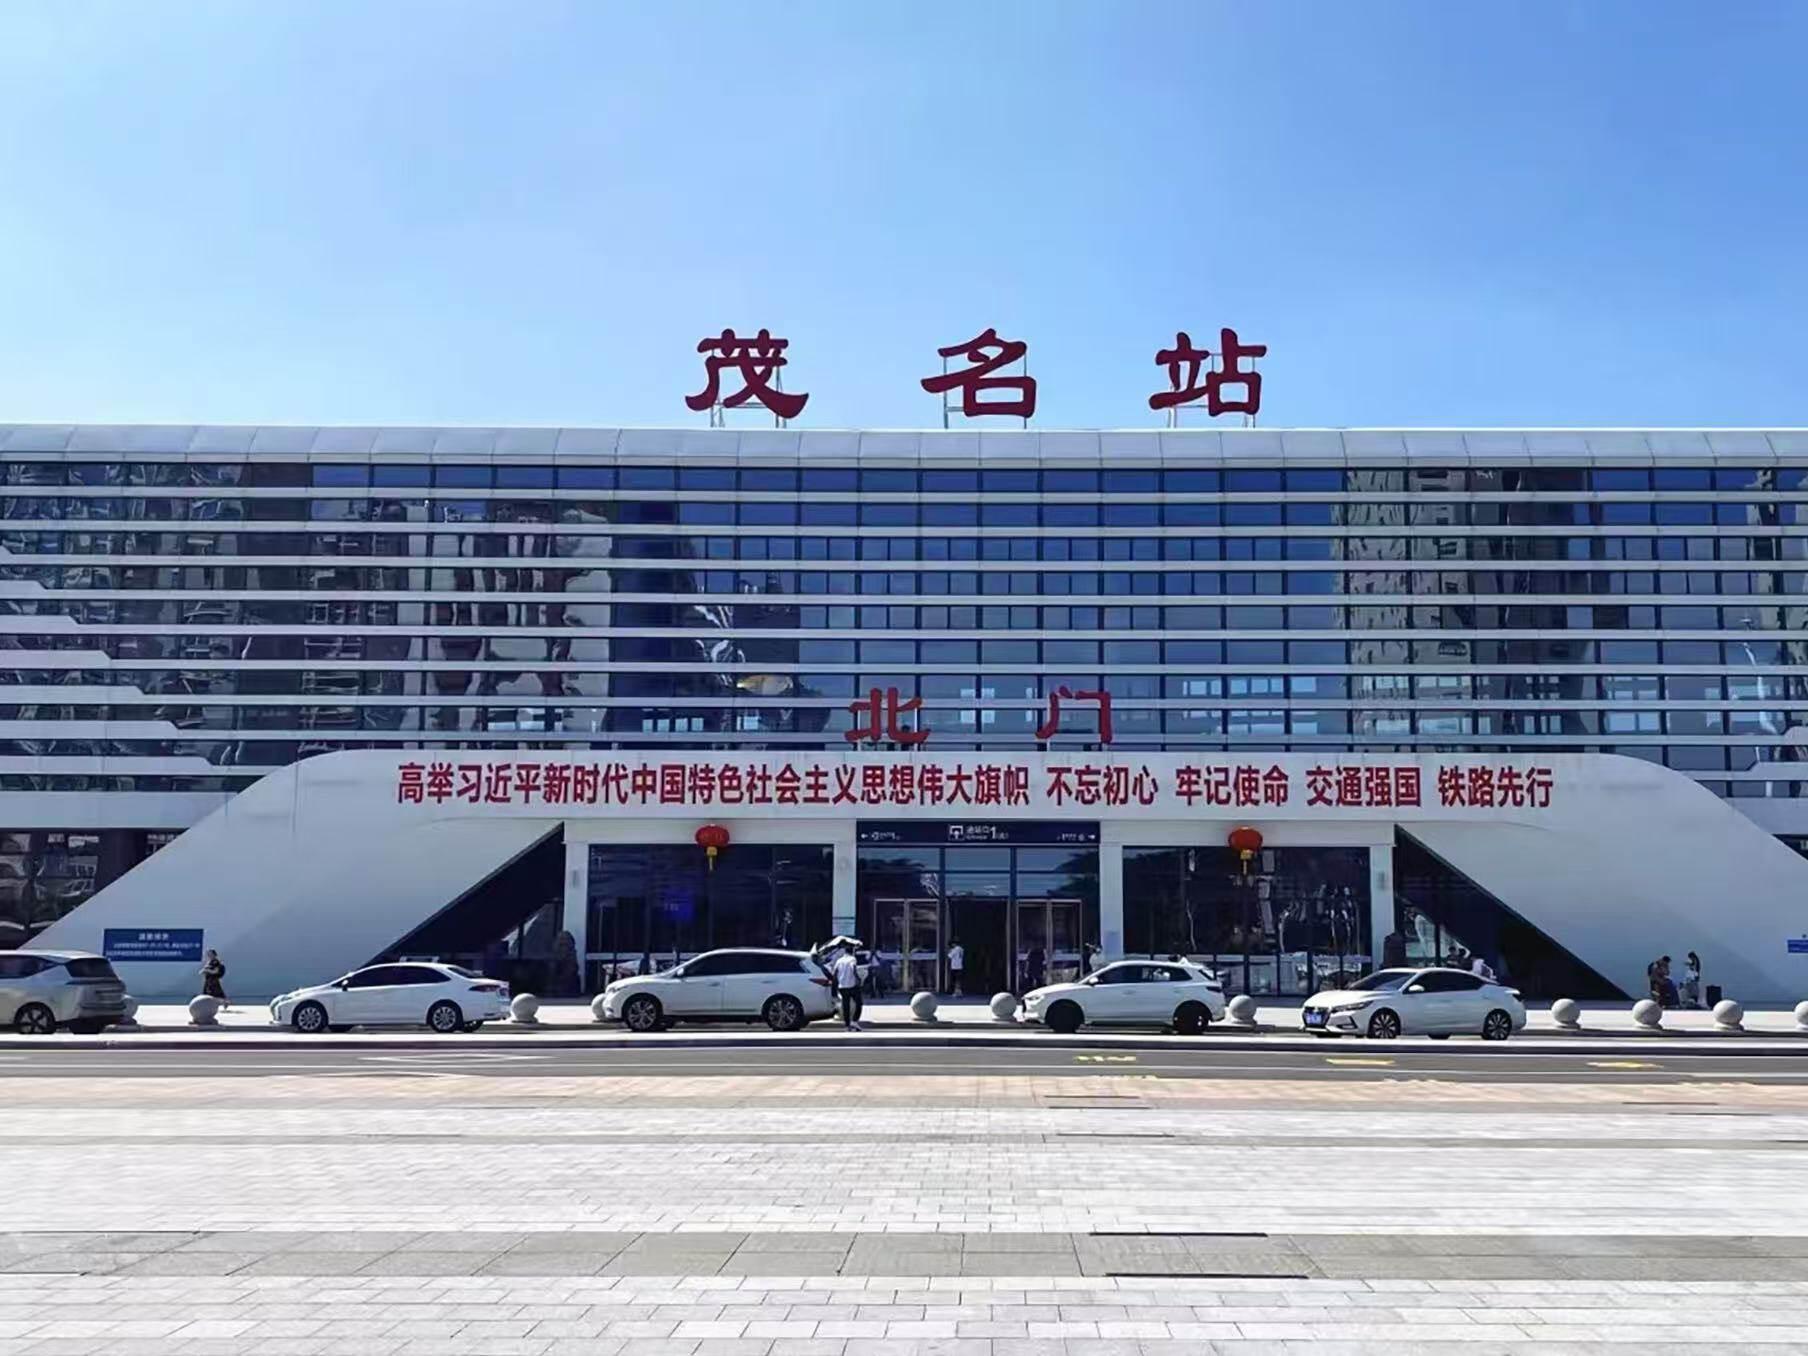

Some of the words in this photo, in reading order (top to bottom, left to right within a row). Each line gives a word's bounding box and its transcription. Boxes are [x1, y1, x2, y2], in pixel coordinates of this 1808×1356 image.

[685, 328, 1267, 418] 茂名站
[844, 685, 1112, 744] 北门
[398, 763, 1029, 804] 高举习近平新时代中国特色社会主义思想伟大旗帜
[1046, 765, 1158, 807] 不忘初心
[1175, 766, 1289, 807] 牢记使命
[1305, 766, 1422, 808] 交通强国
[1437, 767, 1554, 808] 铁路先行
